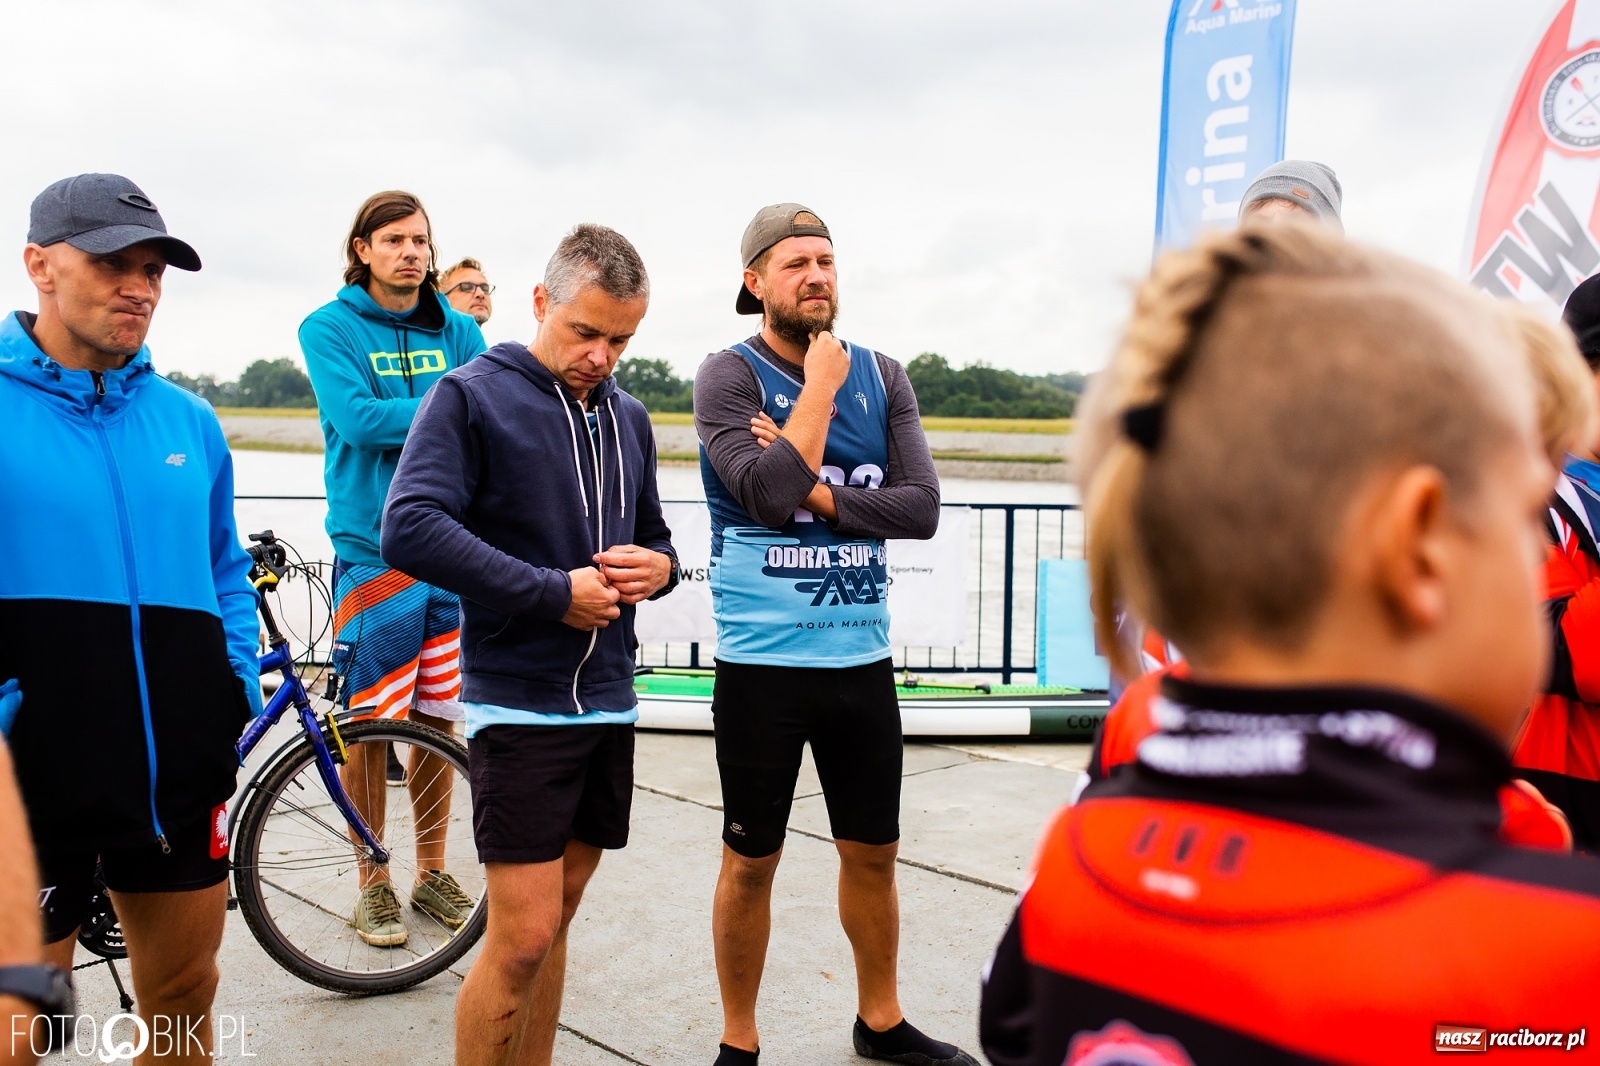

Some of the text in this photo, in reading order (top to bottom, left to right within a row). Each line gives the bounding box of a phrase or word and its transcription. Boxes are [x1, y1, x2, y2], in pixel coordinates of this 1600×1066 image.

[1185, 1, 1283, 34] Aqua Marina
[165, 453, 186, 466] 4F
[768, 546, 831, 569] ODRA
[889, 565, 934, 575] Sportowy
[795, 618, 883, 630] AQUA MARINA
